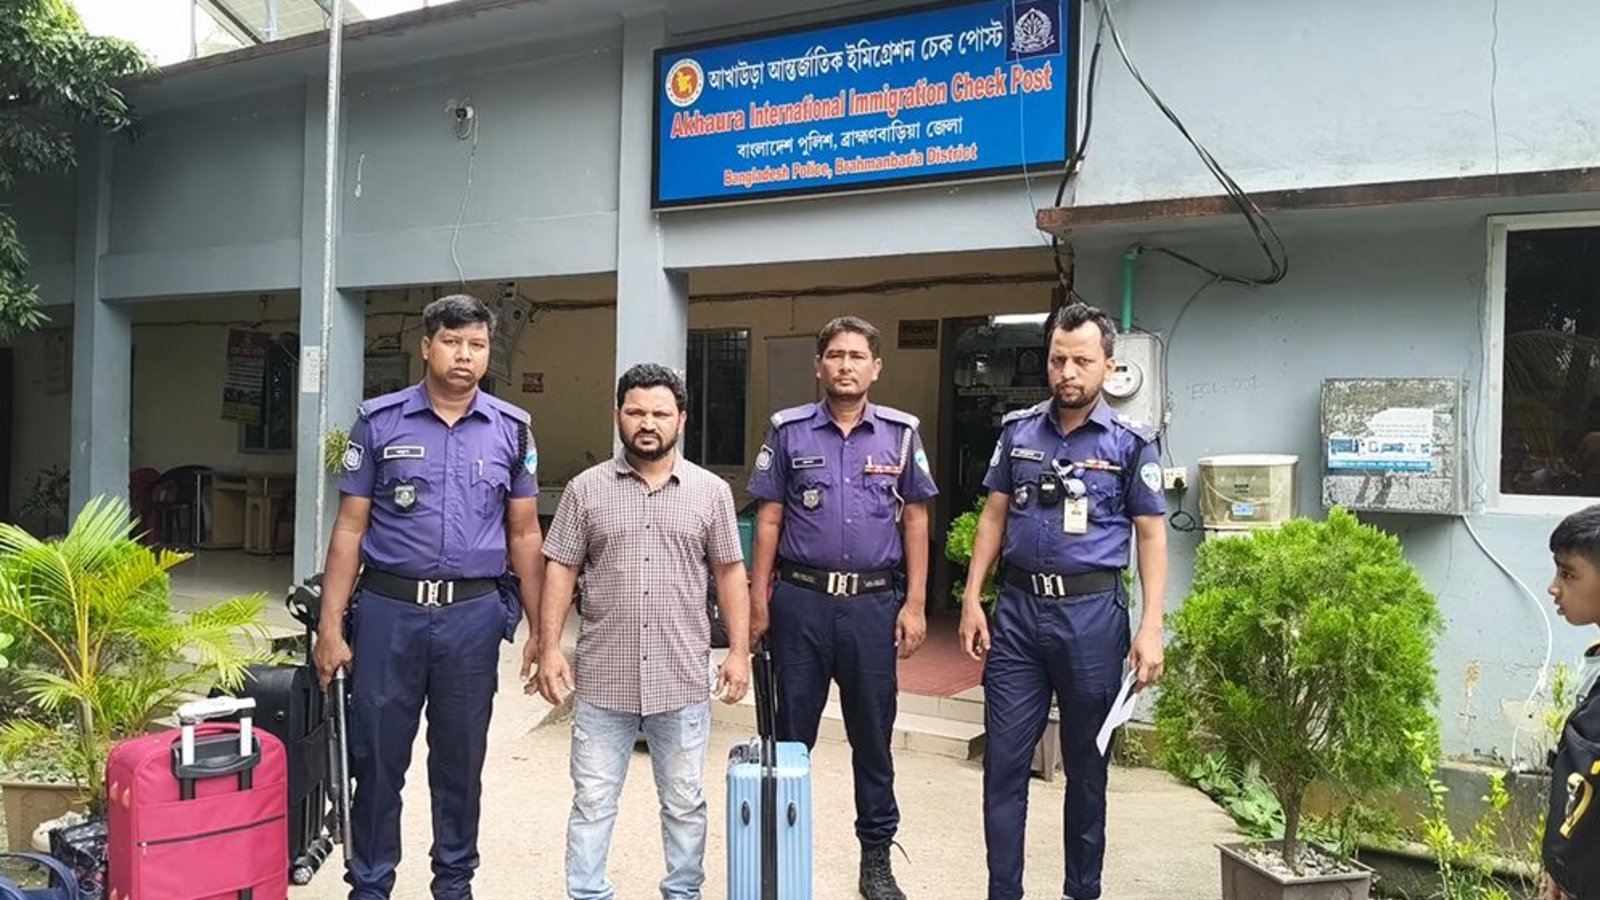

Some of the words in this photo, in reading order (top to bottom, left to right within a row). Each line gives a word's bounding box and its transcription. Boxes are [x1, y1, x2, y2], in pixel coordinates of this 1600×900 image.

[707, 60, 764, 91] আখাউড়া
[767, 45, 843, 82] আন্তর্জাতিক
[845, 38, 916, 74] ইমিগ্রেশন
[921, 33, 954, 61] চেক
[958, 20, 1004, 55] পোস্ট
[671, 107, 745, 139] Akhaura
[749, 87, 845, 129] International
[849, 77, 948, 119] Immigration
[952, 67, 1007, 103] Check
[1010, 61, 1053, 94] Post
[723, 165, 789, 190] Bangladesh
[792, 159, 832, 181] Police,
[834, 149, 923, 175] Brahmanbaria
[926, 142, 979, 164] District
[736, 137, 793, 159] বাংলাদেশ
[798, 129, 838, 156] পুলিশ,
[926, 117, 963, 137] জেলা
